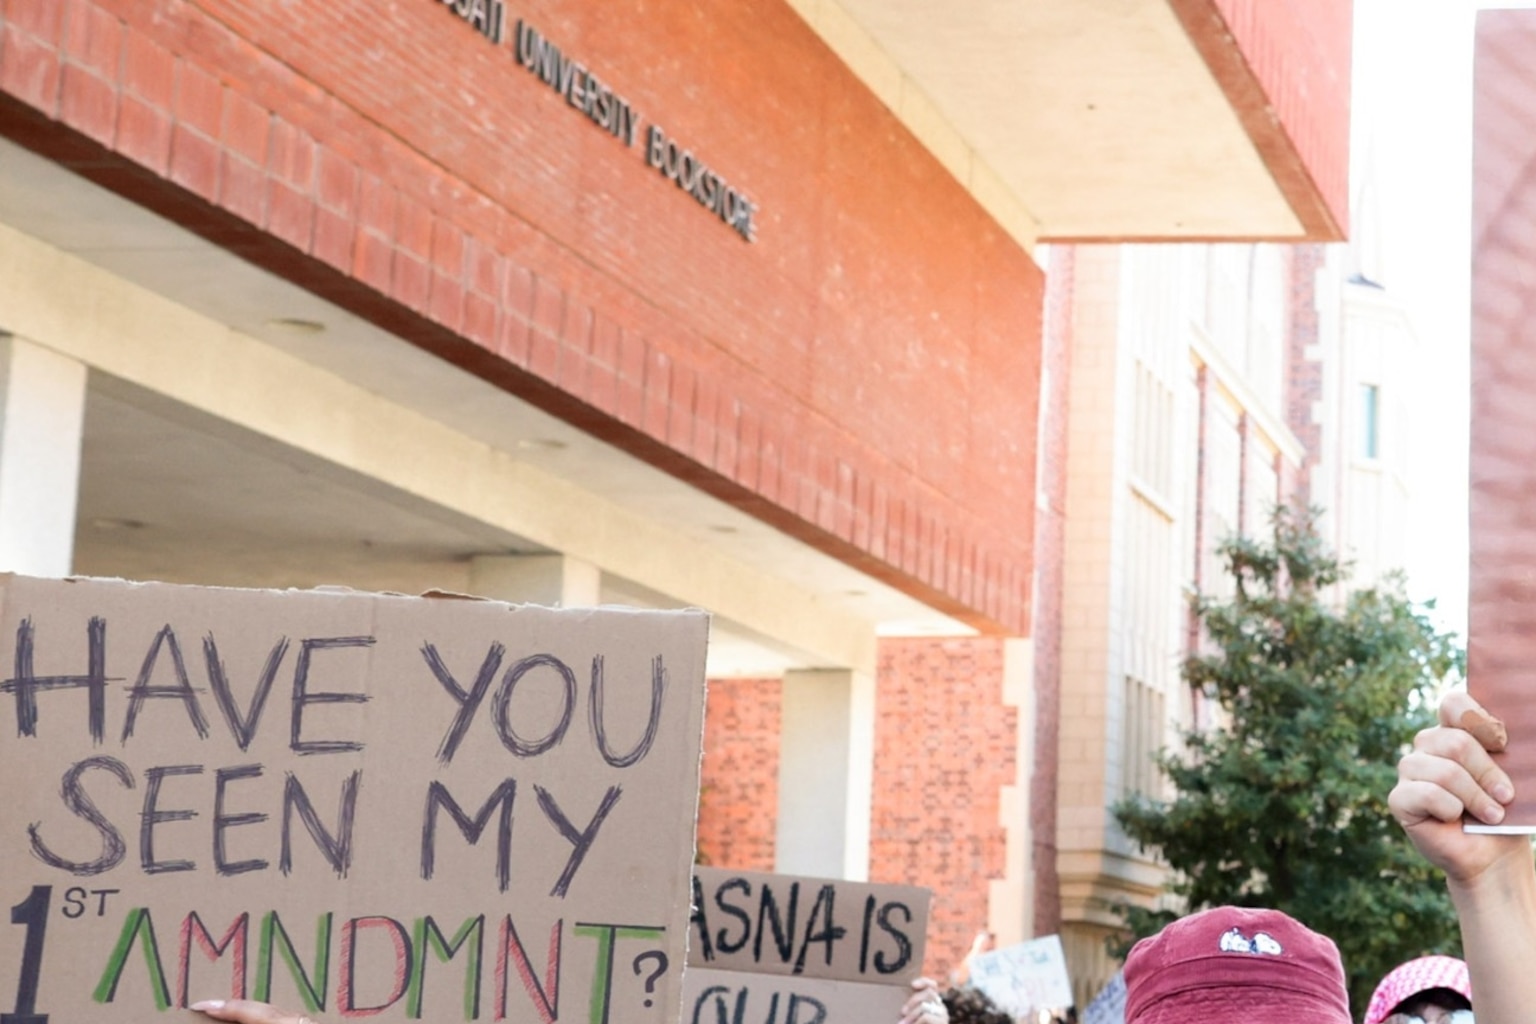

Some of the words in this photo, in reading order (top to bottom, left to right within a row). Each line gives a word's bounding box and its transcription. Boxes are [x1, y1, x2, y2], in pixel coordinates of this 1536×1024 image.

[515, 18, 643, 148] UNIVERSITY
[646, 124, 759, 243] BOOKSTORE
[0, 615, 376, 756] HAVE
[418, 640, 668, 769] YOU
[27, 755, 363, 880] SEEN
[421, 776, 623, 899] MY
[858, 893, 912, 975] IS
